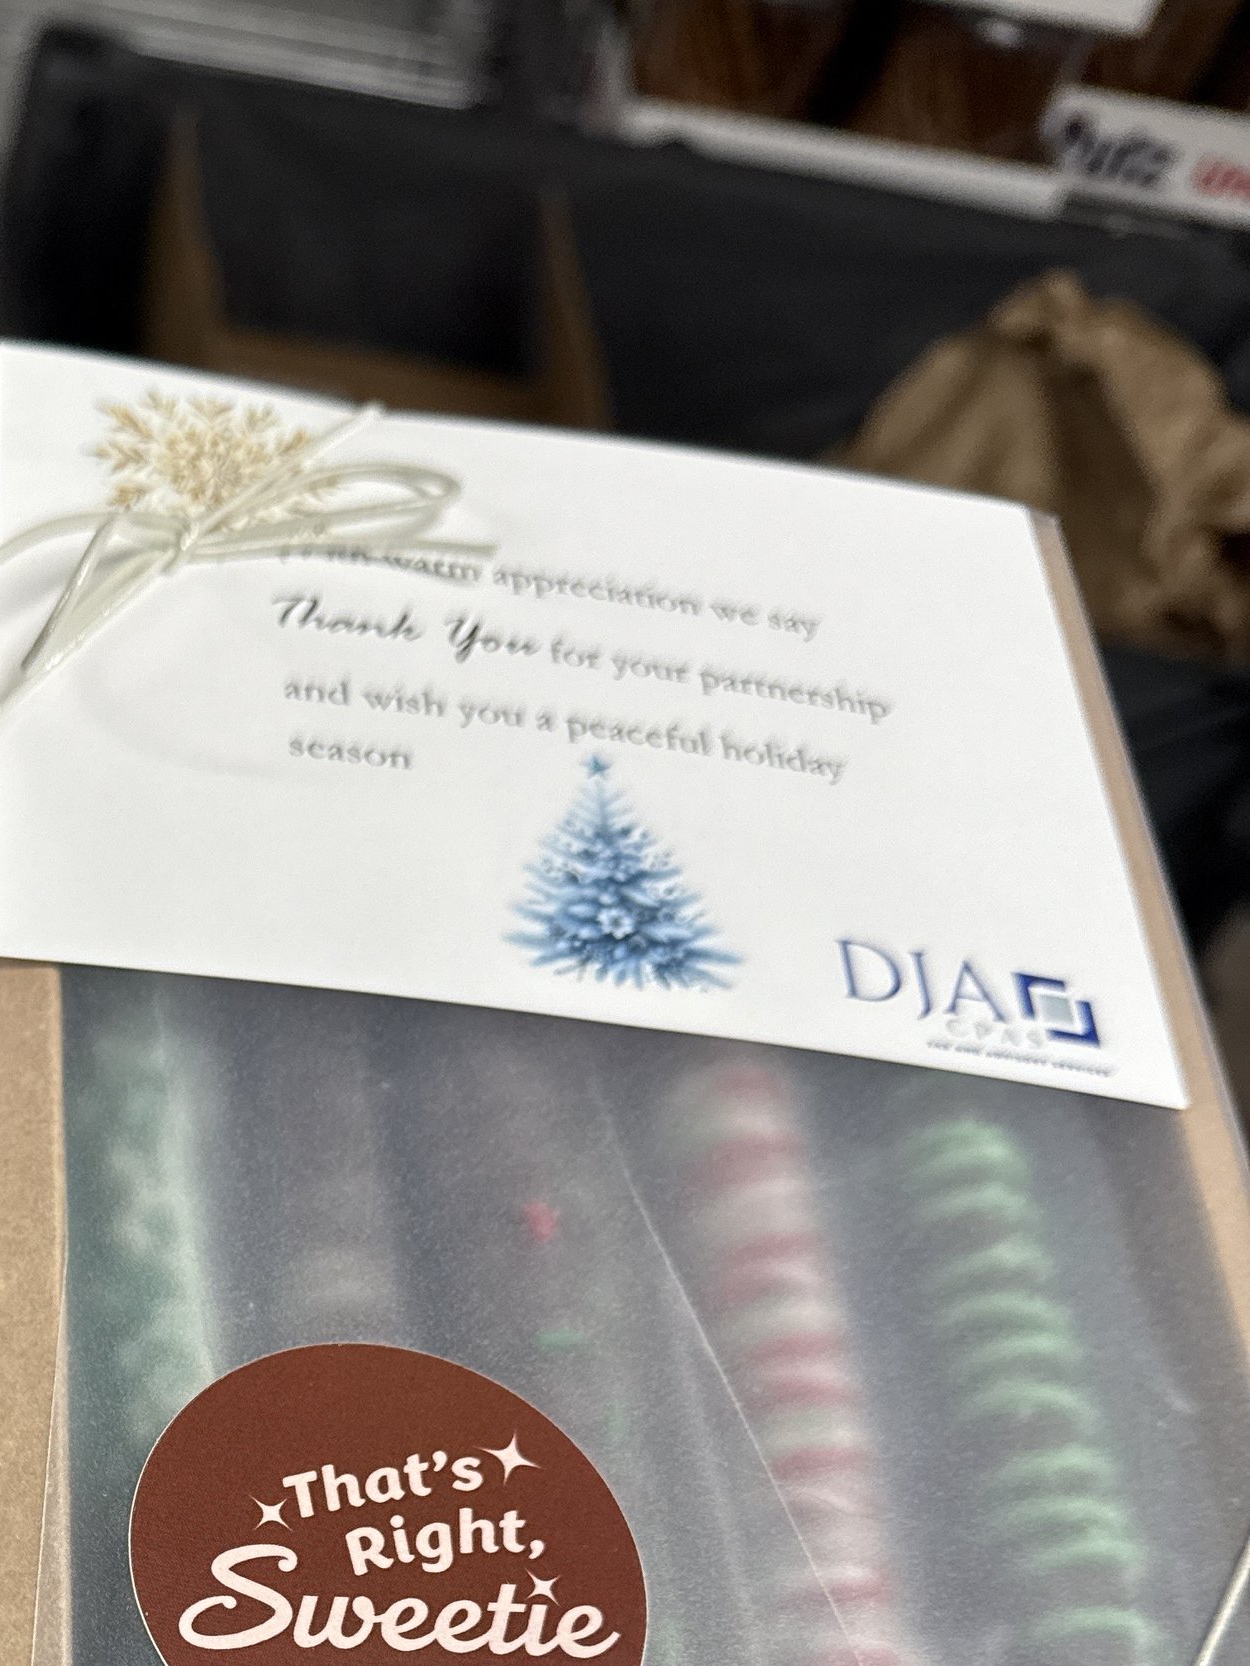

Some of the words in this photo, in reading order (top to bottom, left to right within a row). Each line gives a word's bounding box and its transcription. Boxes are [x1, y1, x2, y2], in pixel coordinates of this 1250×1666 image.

[493, 567, 700, 616] appreciation
[708, 597, 759, 626] we
[767, 605, 821, 642] say
[272, 593, 422, 641] Thank
[446, 608, 541, 663] You
[550, 632, 601, 670] for
[611, 651, 690, 683] your
[700, 667, 896, 725] partnership
[283, 675, 350, 706] and
[361, 684, 447, 717] wish
[458, 698, 527, 728] you
[535, 707, 555, 732] a
[566, 713, 712, 756] peaceful
[720, 729, 845, 785] holiday
[288, 732, 412, 770] season
[837, 938, 1007, 1022] DJA
[283, 1449, 483, 1519] That's
[344, 1507, 546, 1577] Right,
[178, 1543, 622, 1660] Sweetie
